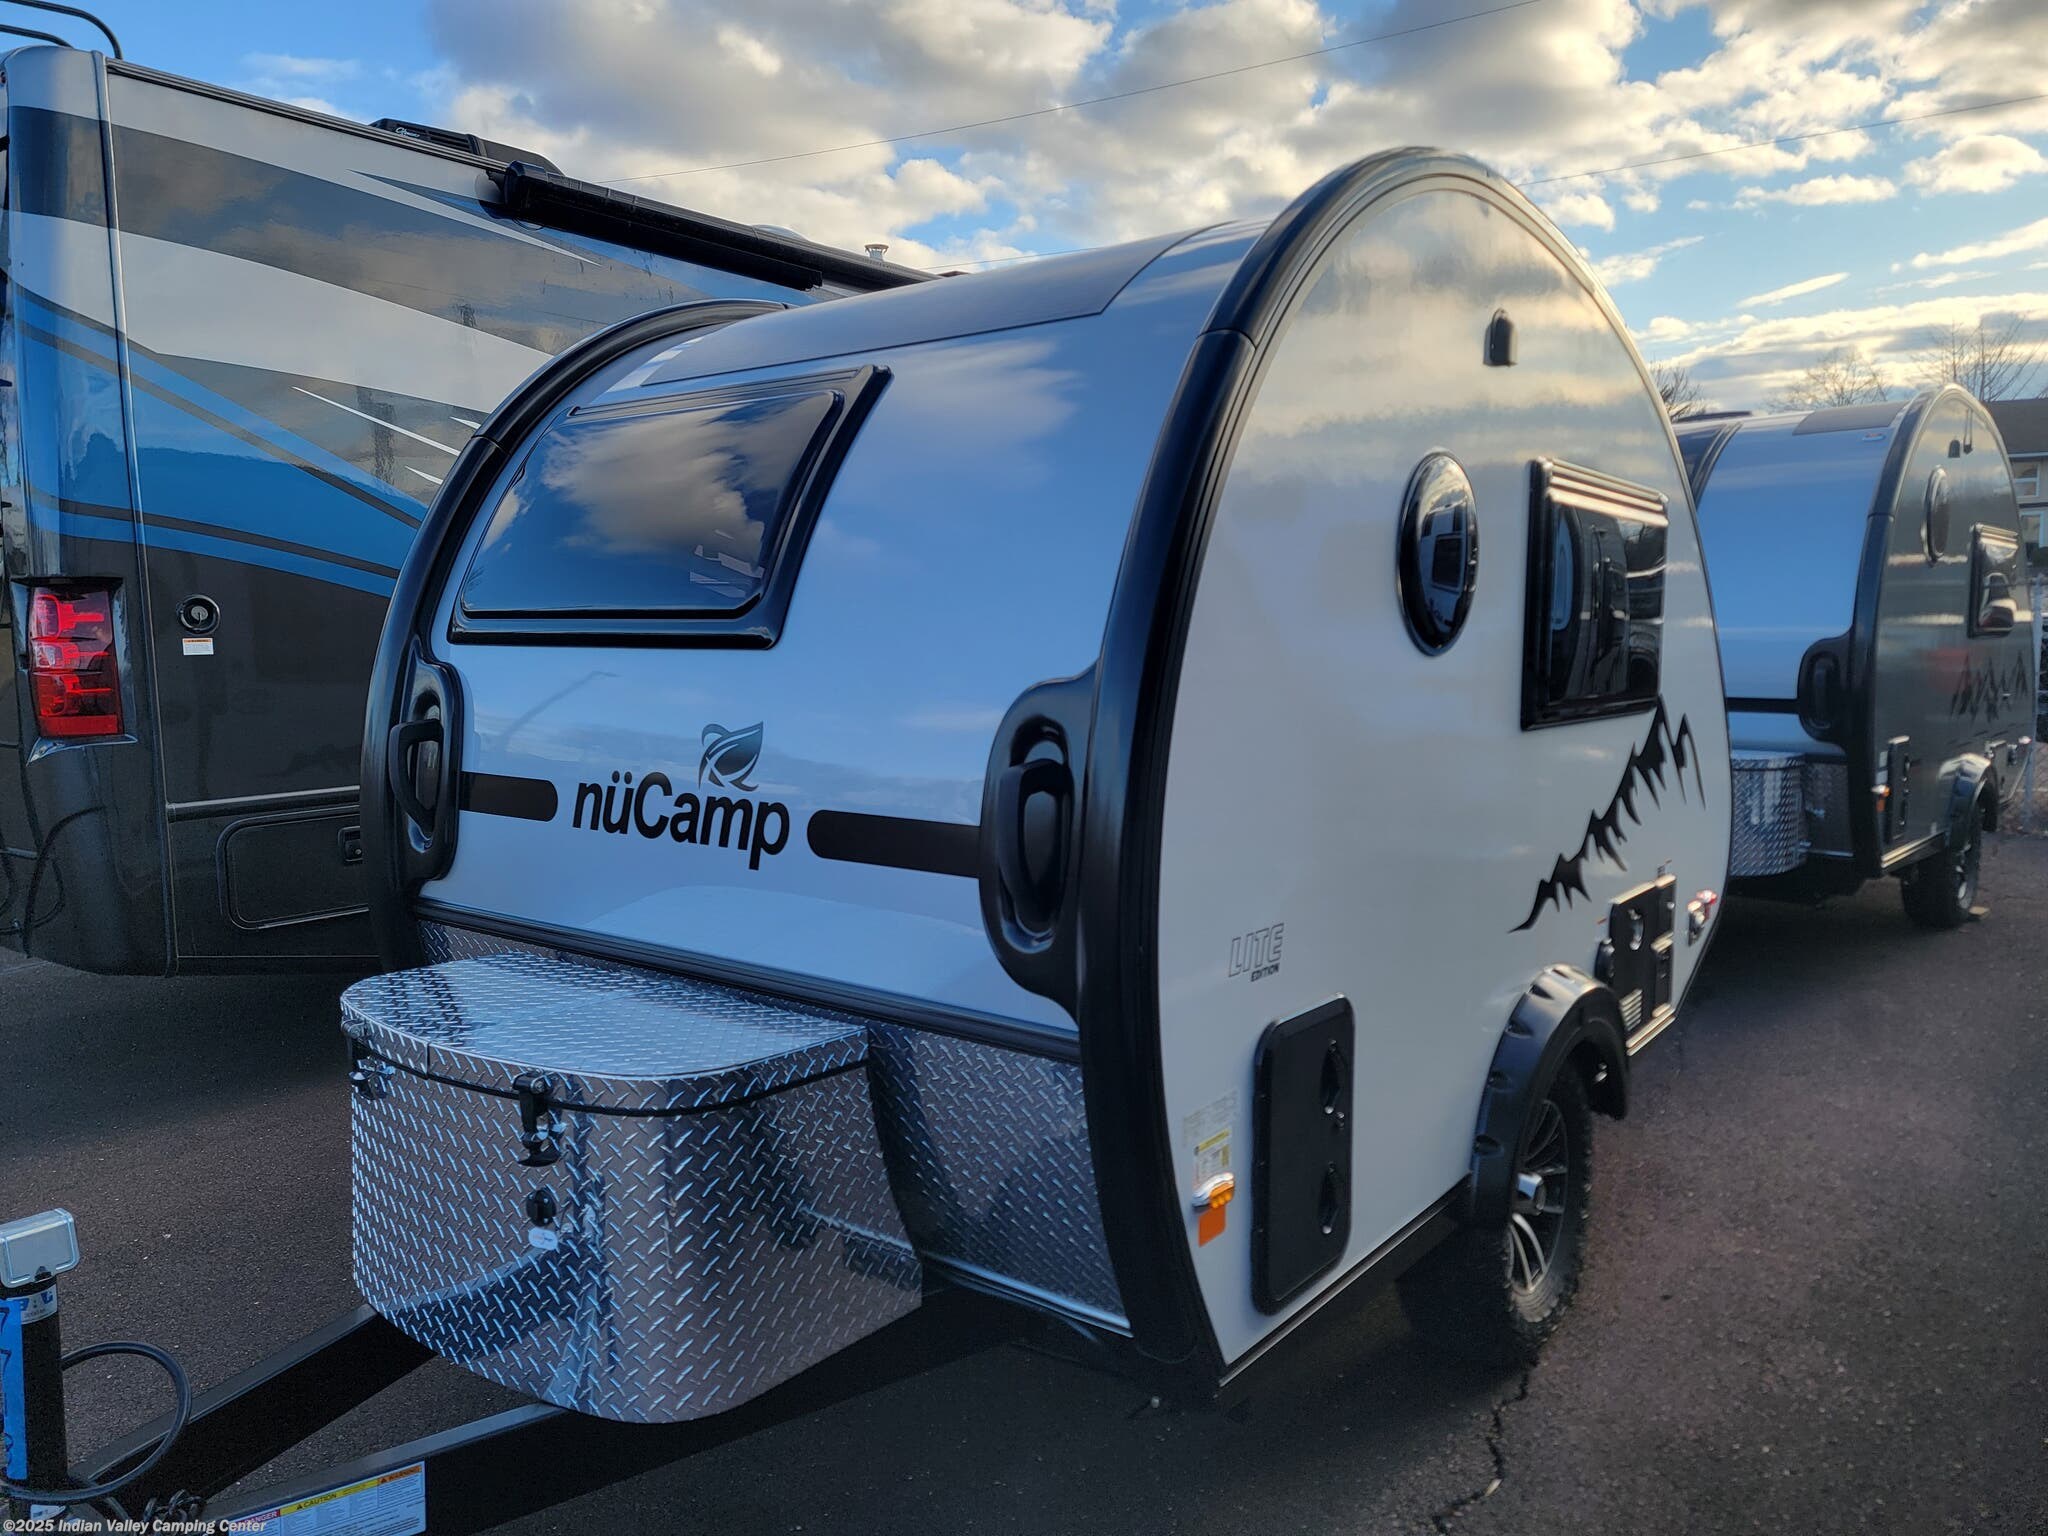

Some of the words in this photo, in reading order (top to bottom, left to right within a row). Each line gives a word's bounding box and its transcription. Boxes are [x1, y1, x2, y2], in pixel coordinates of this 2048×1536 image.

[572, 770, 790, 871] nüCamp
[1228, 922, 1284, 977] LITE
[1251, 963, 1280, 981] EDITION
[303, 1493, 337, 1506] CAUTION
